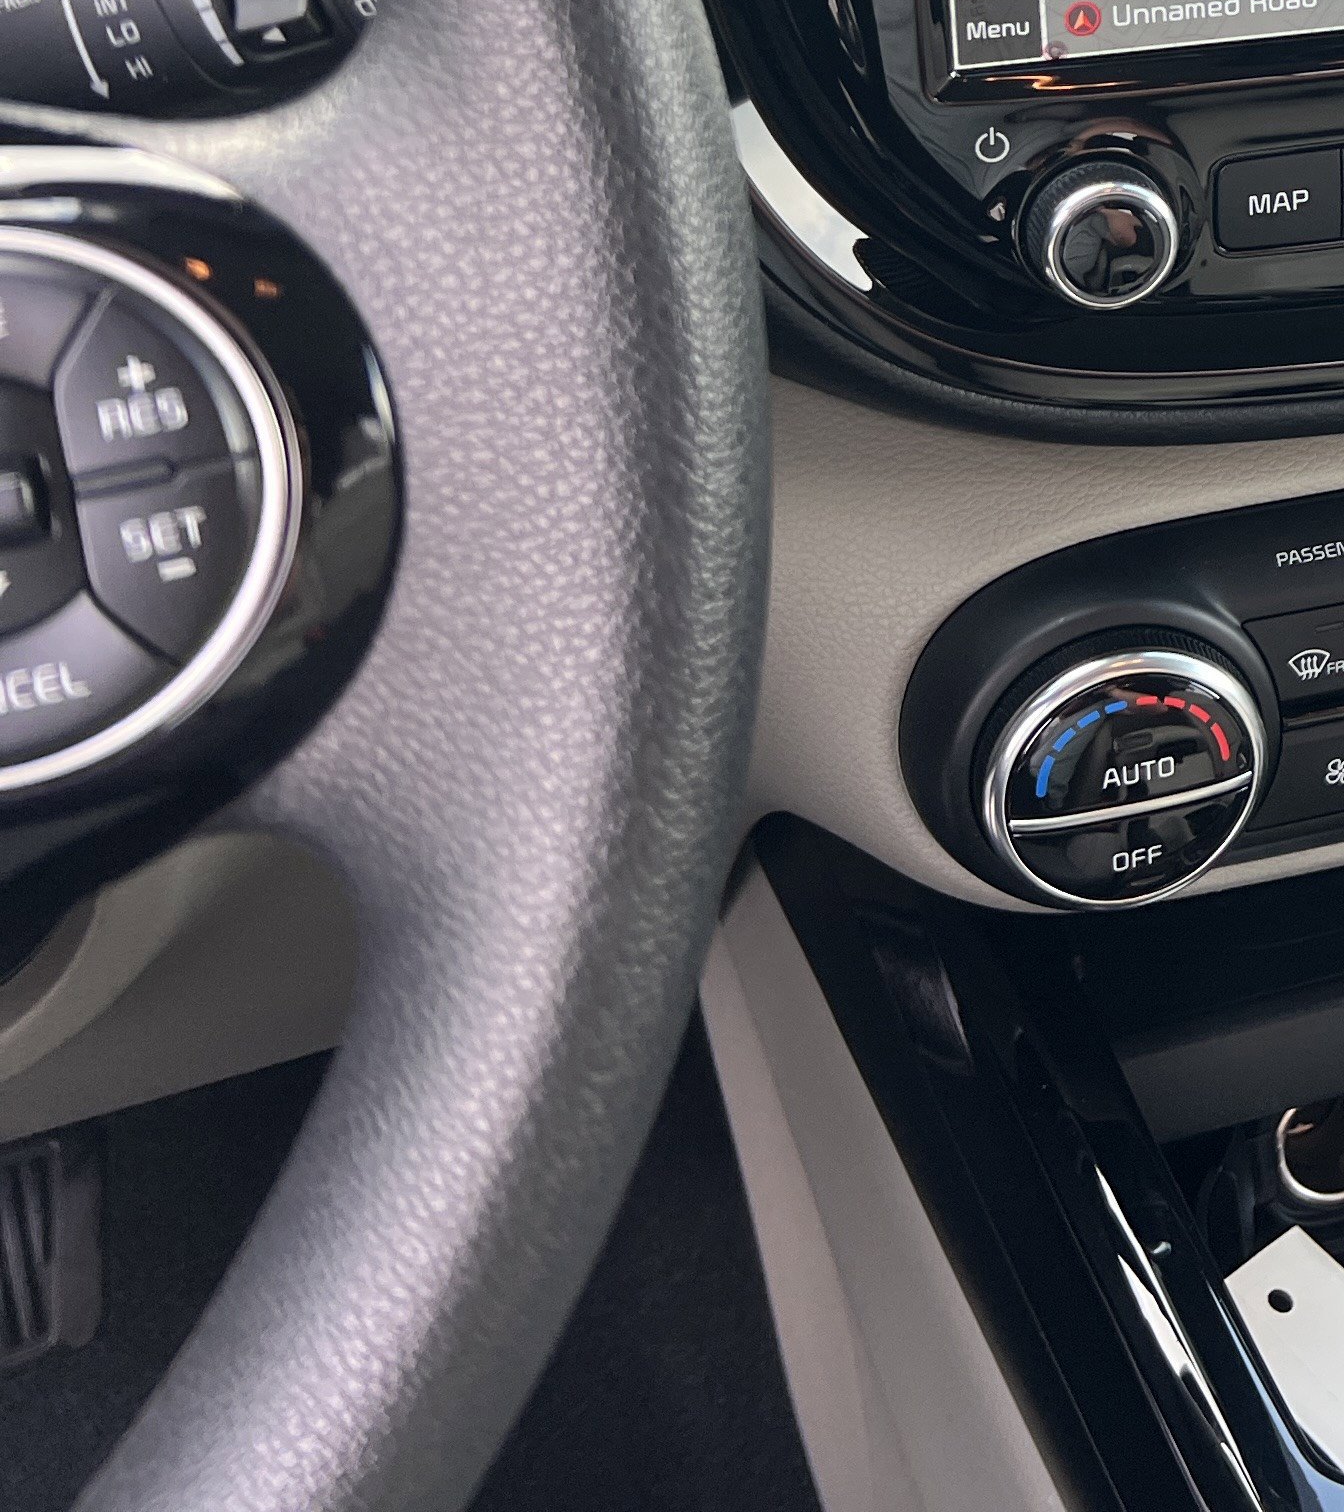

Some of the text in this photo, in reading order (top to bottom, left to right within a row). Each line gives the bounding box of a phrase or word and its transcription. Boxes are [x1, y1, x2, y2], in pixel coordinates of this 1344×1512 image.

[105, 19, 142, 49] LO
[966, 19, 1030, 41] Menu
[124, 54, 153, 81] HI
[1247, 189, 1309, 216] MAP
[1102, 756, 1176, 790] AUTO
[1112, 844, 1163, 872] OFF
